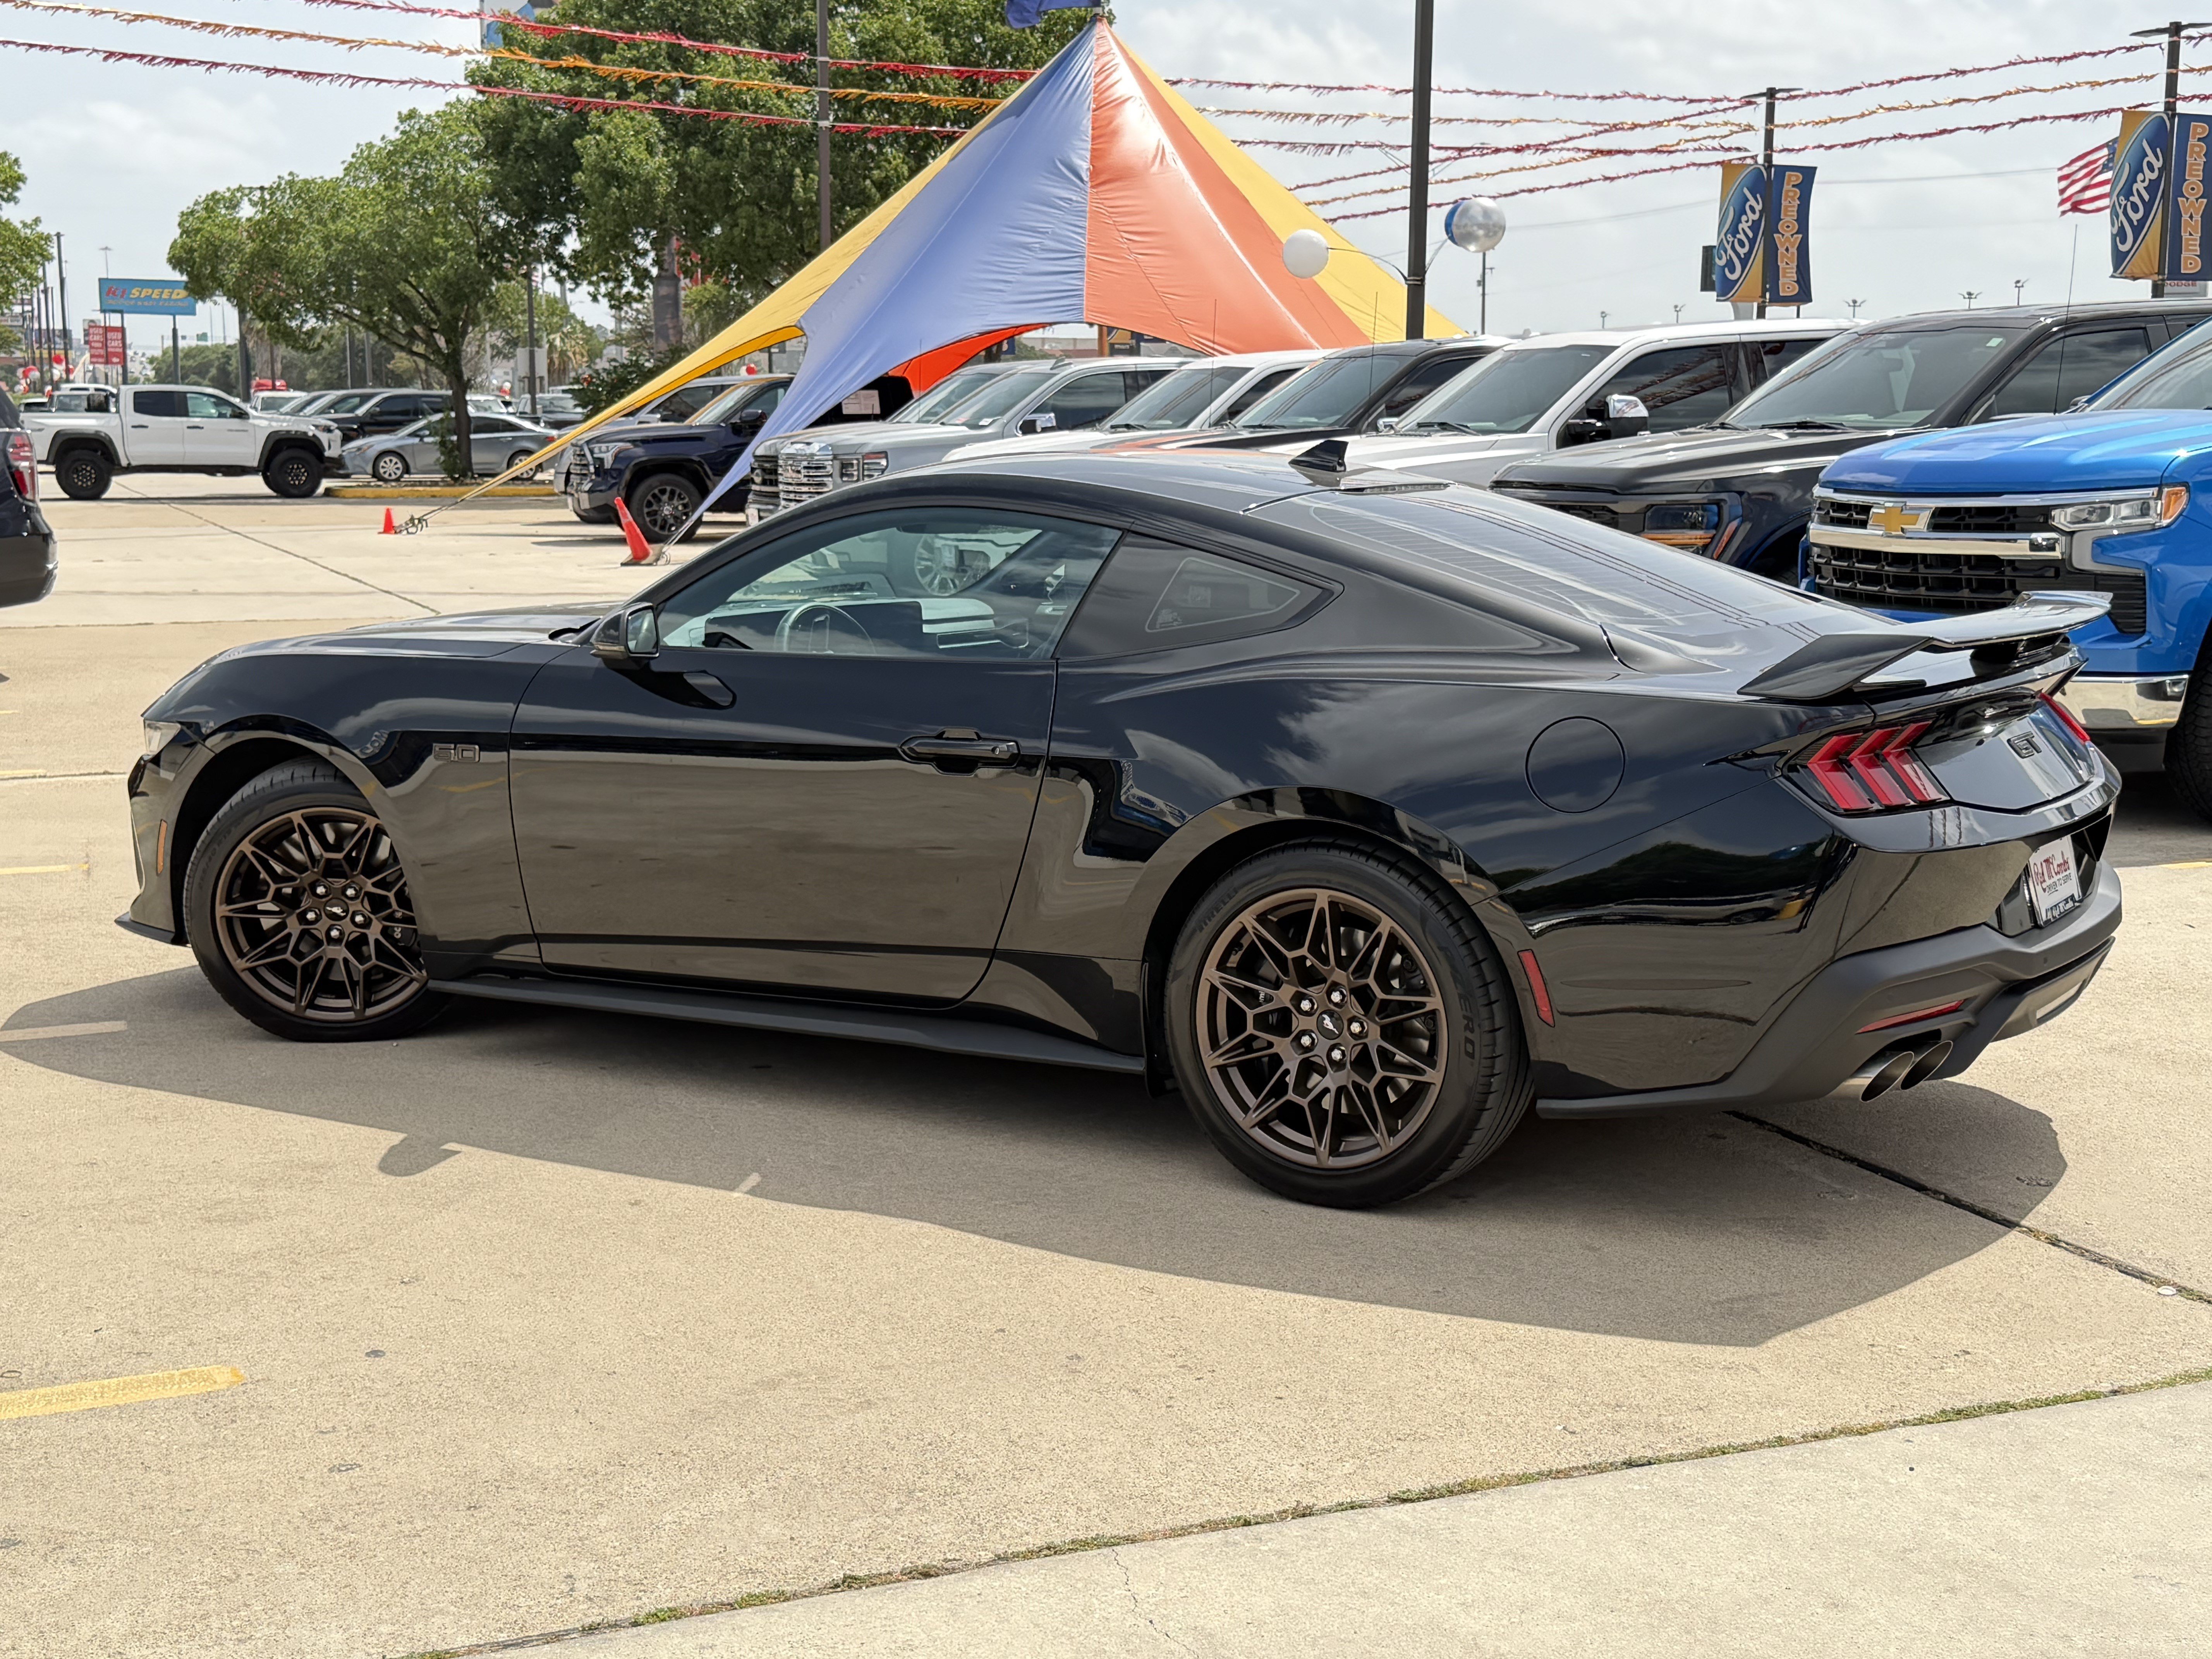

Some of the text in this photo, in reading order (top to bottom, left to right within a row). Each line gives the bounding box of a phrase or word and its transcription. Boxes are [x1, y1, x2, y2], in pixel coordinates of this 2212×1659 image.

[1715, 187, 1763, 281] Ford
[1774, 172, 1802, 296] PREOWNED
[2111, 138, 2164, 252] Ford
[2178, 122, 2209, 274] PREOWNED
[130, 287, 189, 299] SPEED
[2006, 731, 2042, 759] GT
